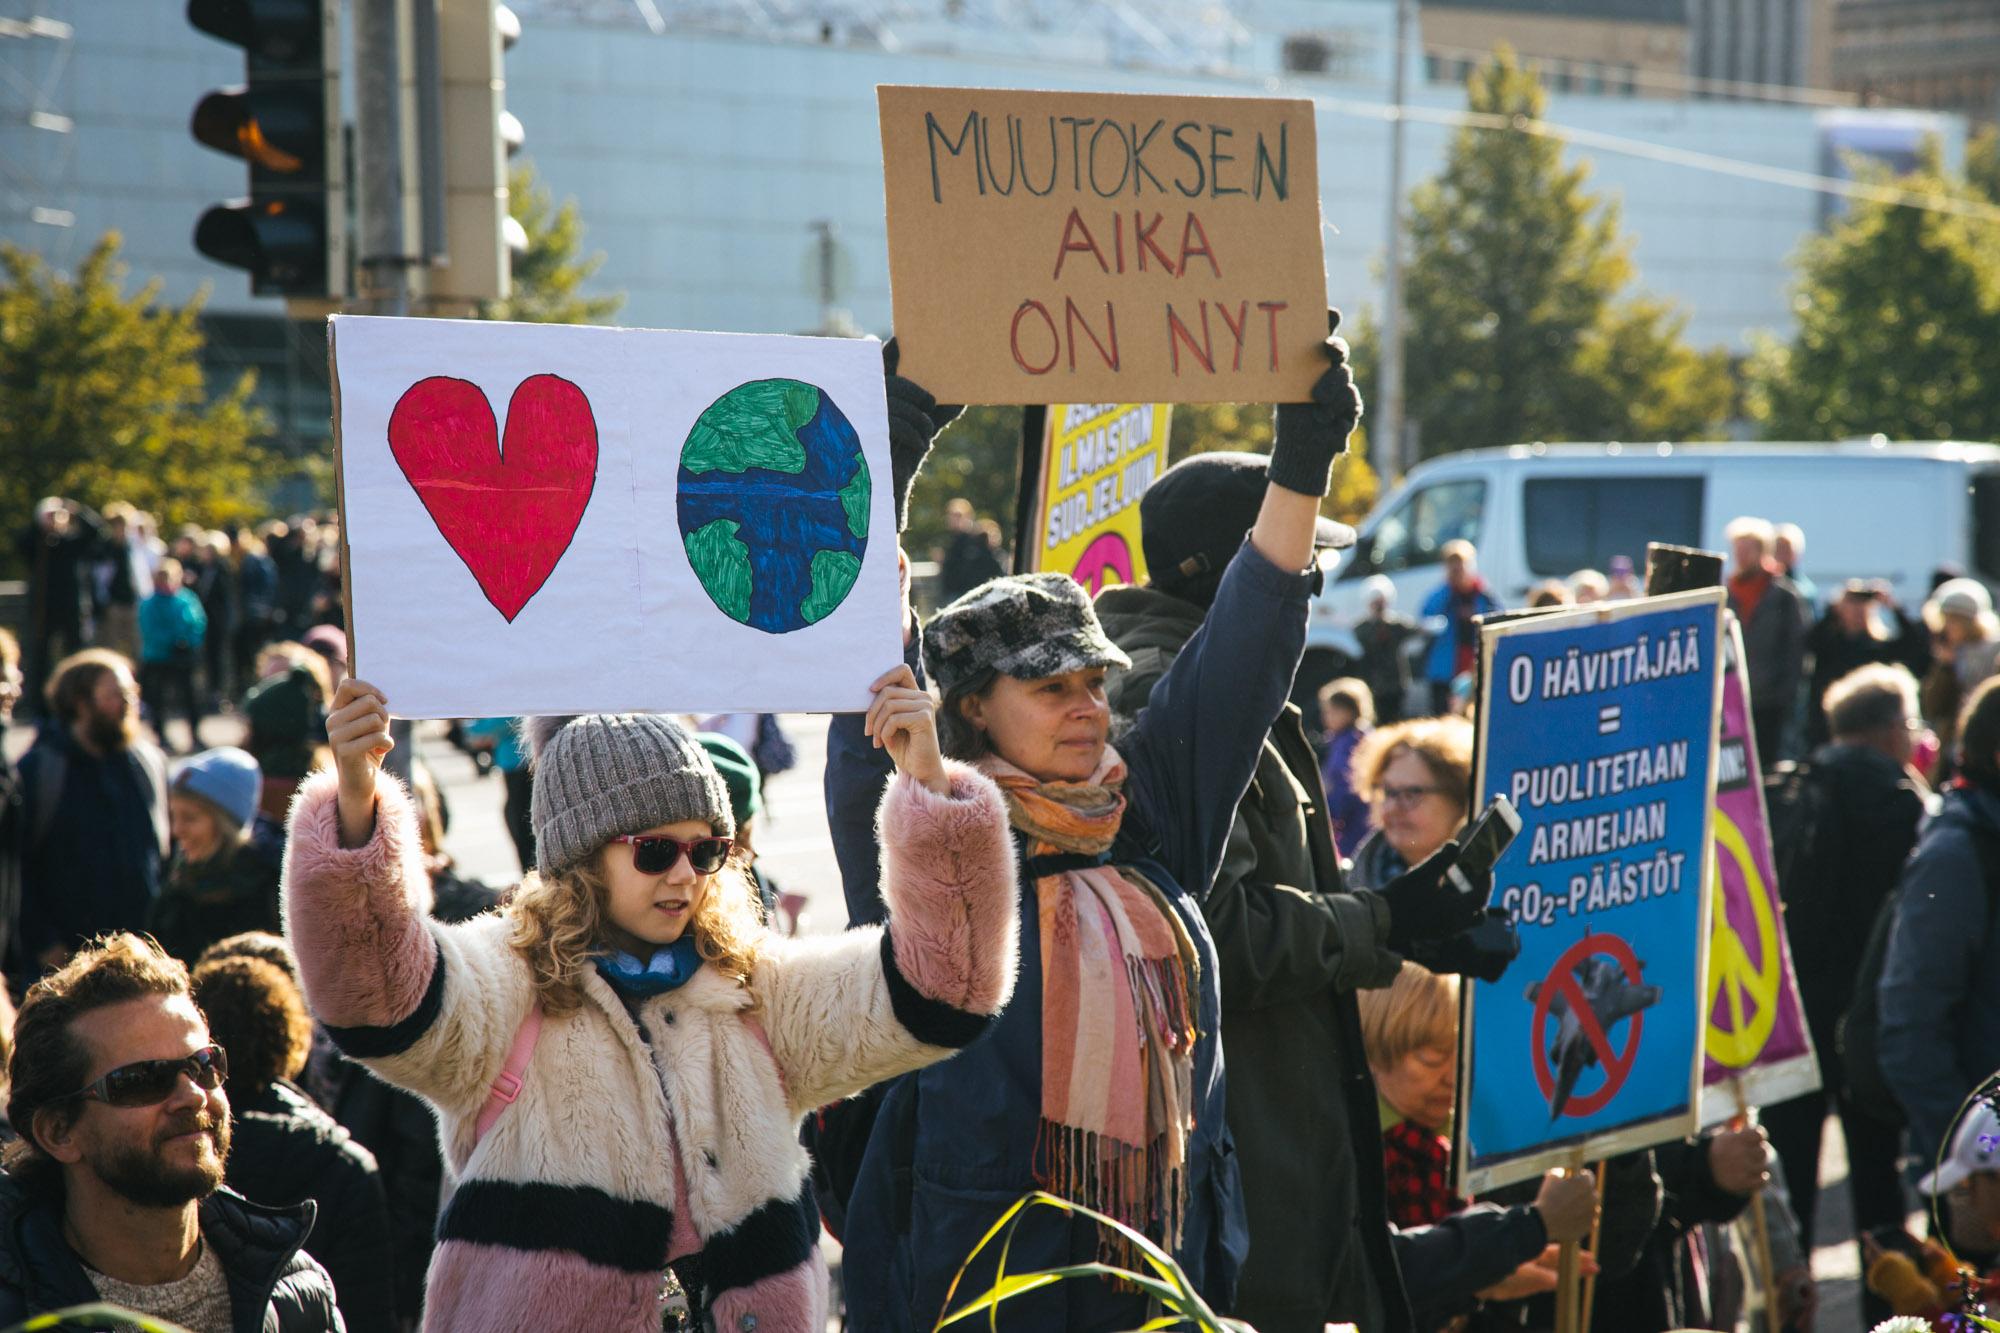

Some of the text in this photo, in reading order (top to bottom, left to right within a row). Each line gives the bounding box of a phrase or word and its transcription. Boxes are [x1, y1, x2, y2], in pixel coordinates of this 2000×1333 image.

[925, 110, 1289, 203] MUUTOKSEN
[1053, 207, 1222, 280] AIKA
[1010, 296, 1288, 376] ON NYT
[1542, 627, 1700, 699] HÄVITTÄJÄÄ
[1511, 740, 1689, 808] PUOLITETAAN
[1529, 802, 1666, 865] ARMEIJAN
